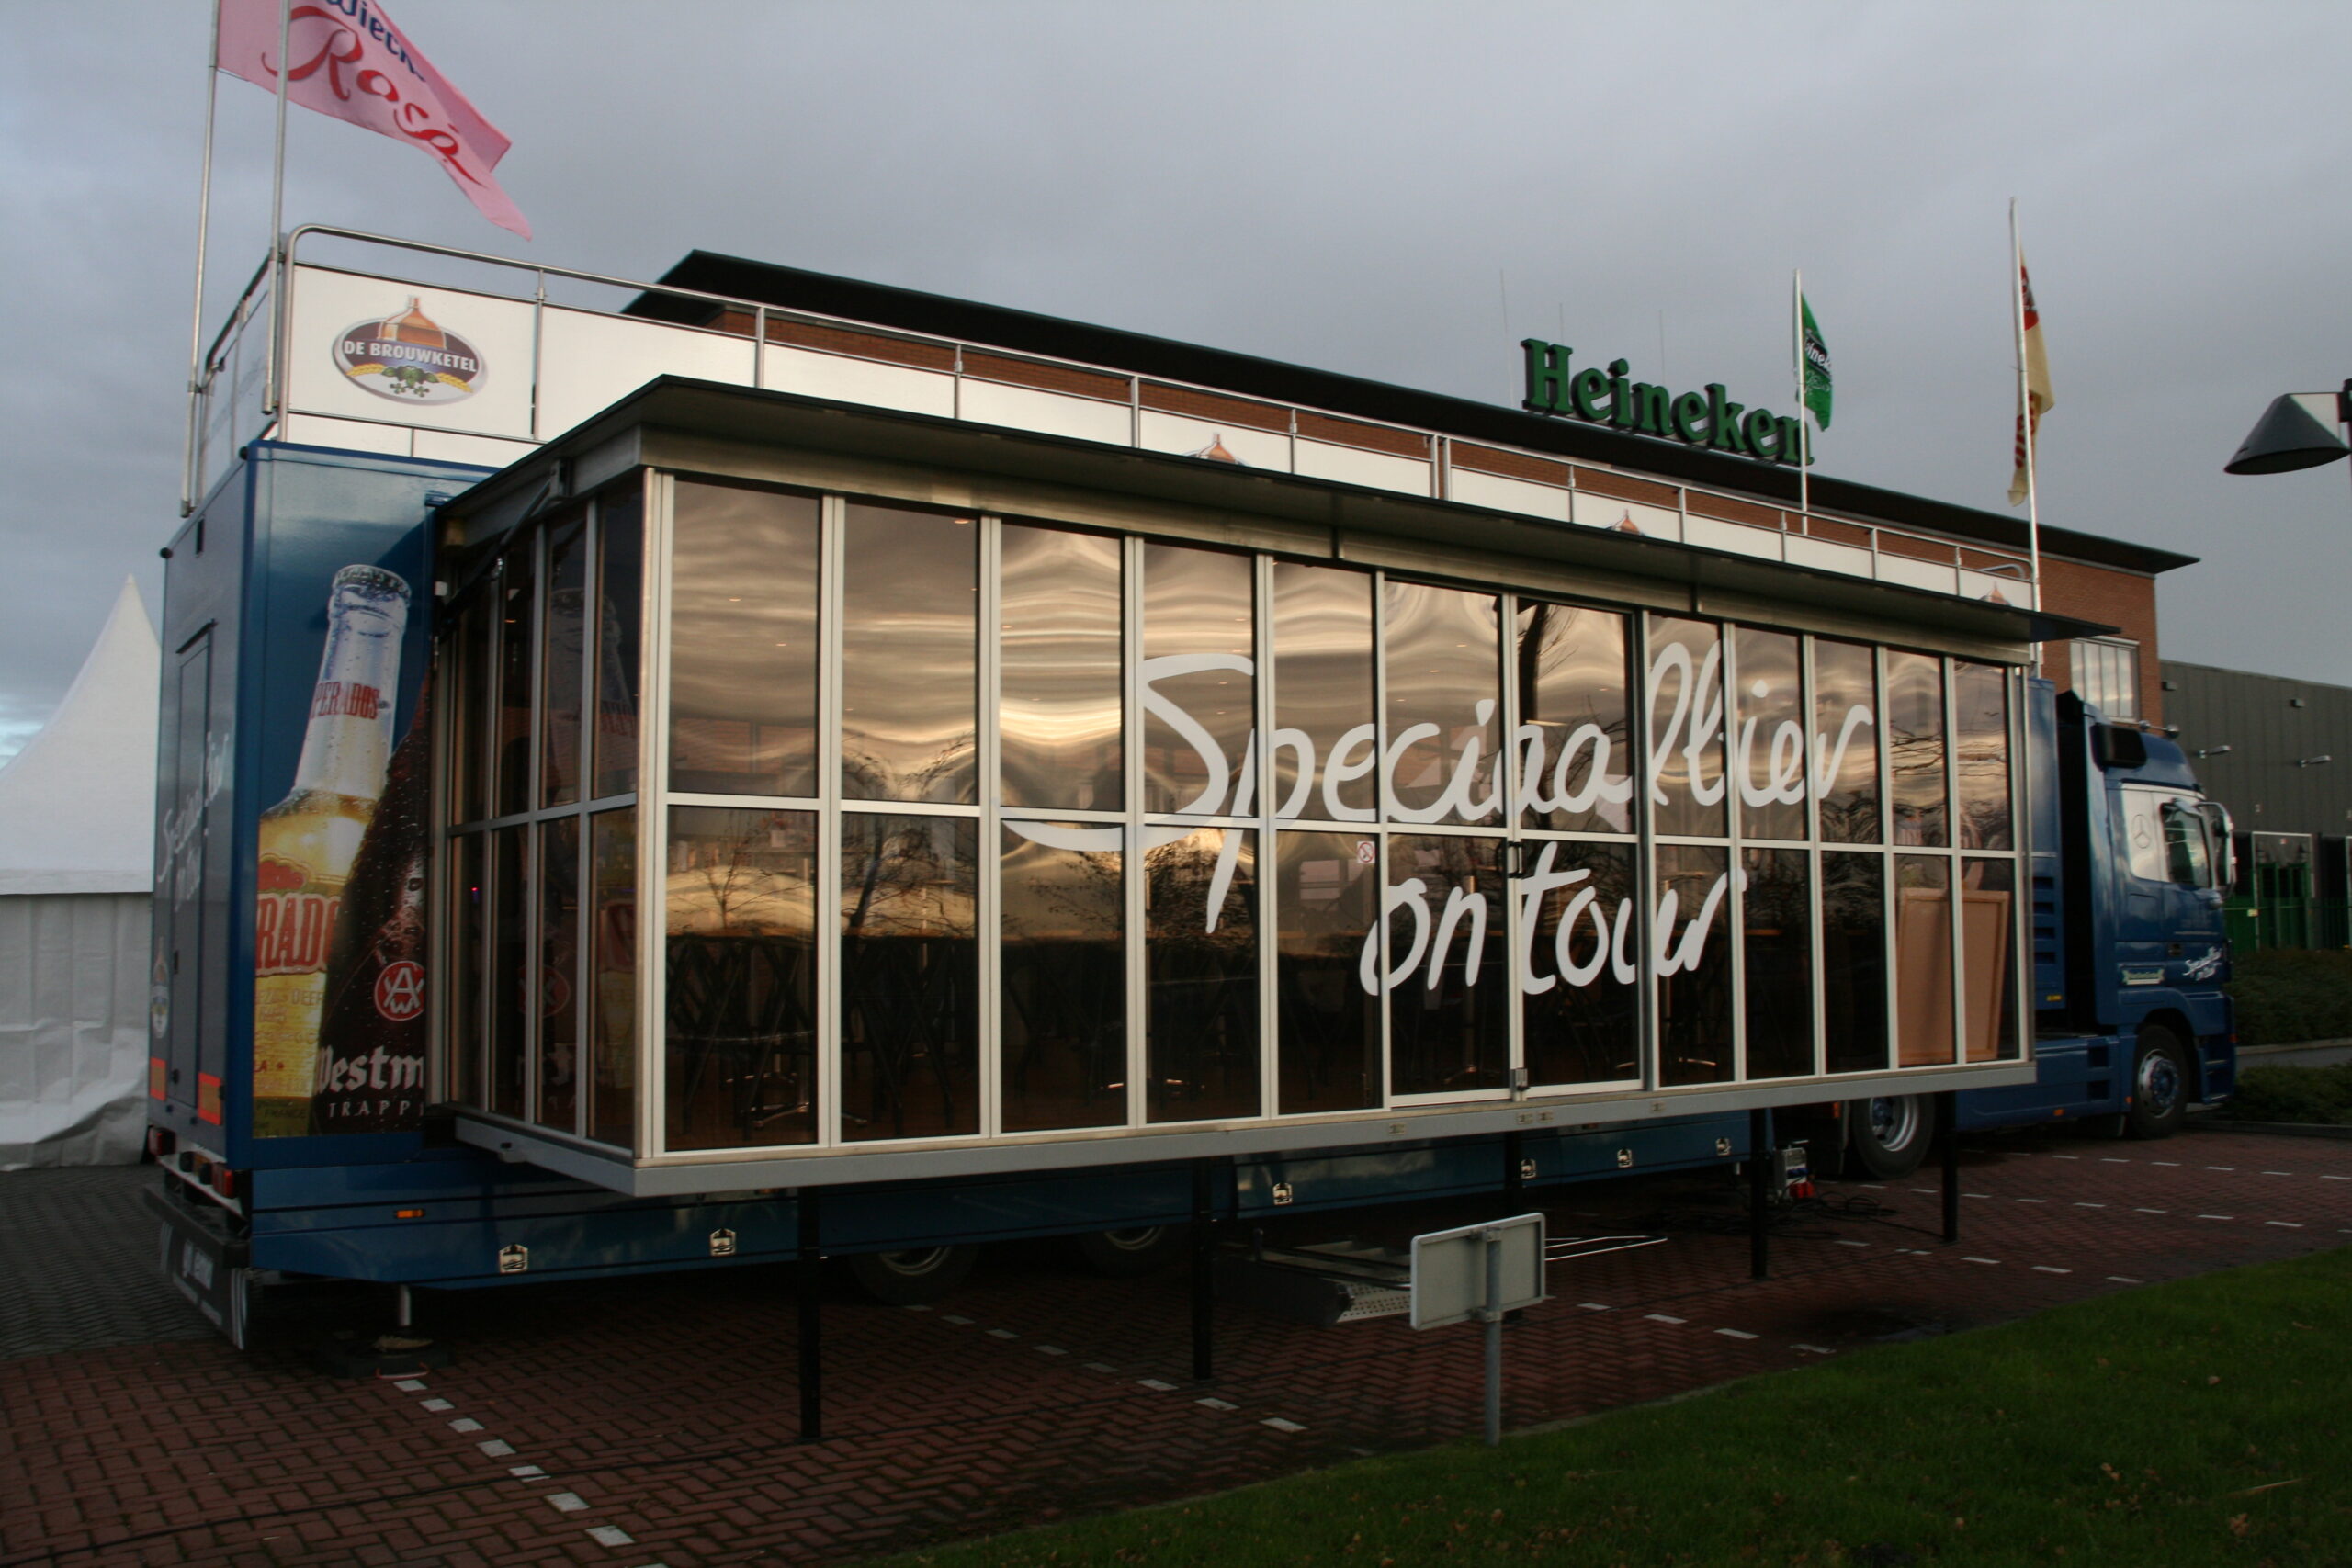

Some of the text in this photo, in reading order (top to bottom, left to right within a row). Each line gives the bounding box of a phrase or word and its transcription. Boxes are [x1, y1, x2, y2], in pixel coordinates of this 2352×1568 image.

[344, 340, 477, 373] DE BROUWKETEL
[1521, 337, 1815, 466] Heineken
[1360, 841, 1747, 998] on tour
